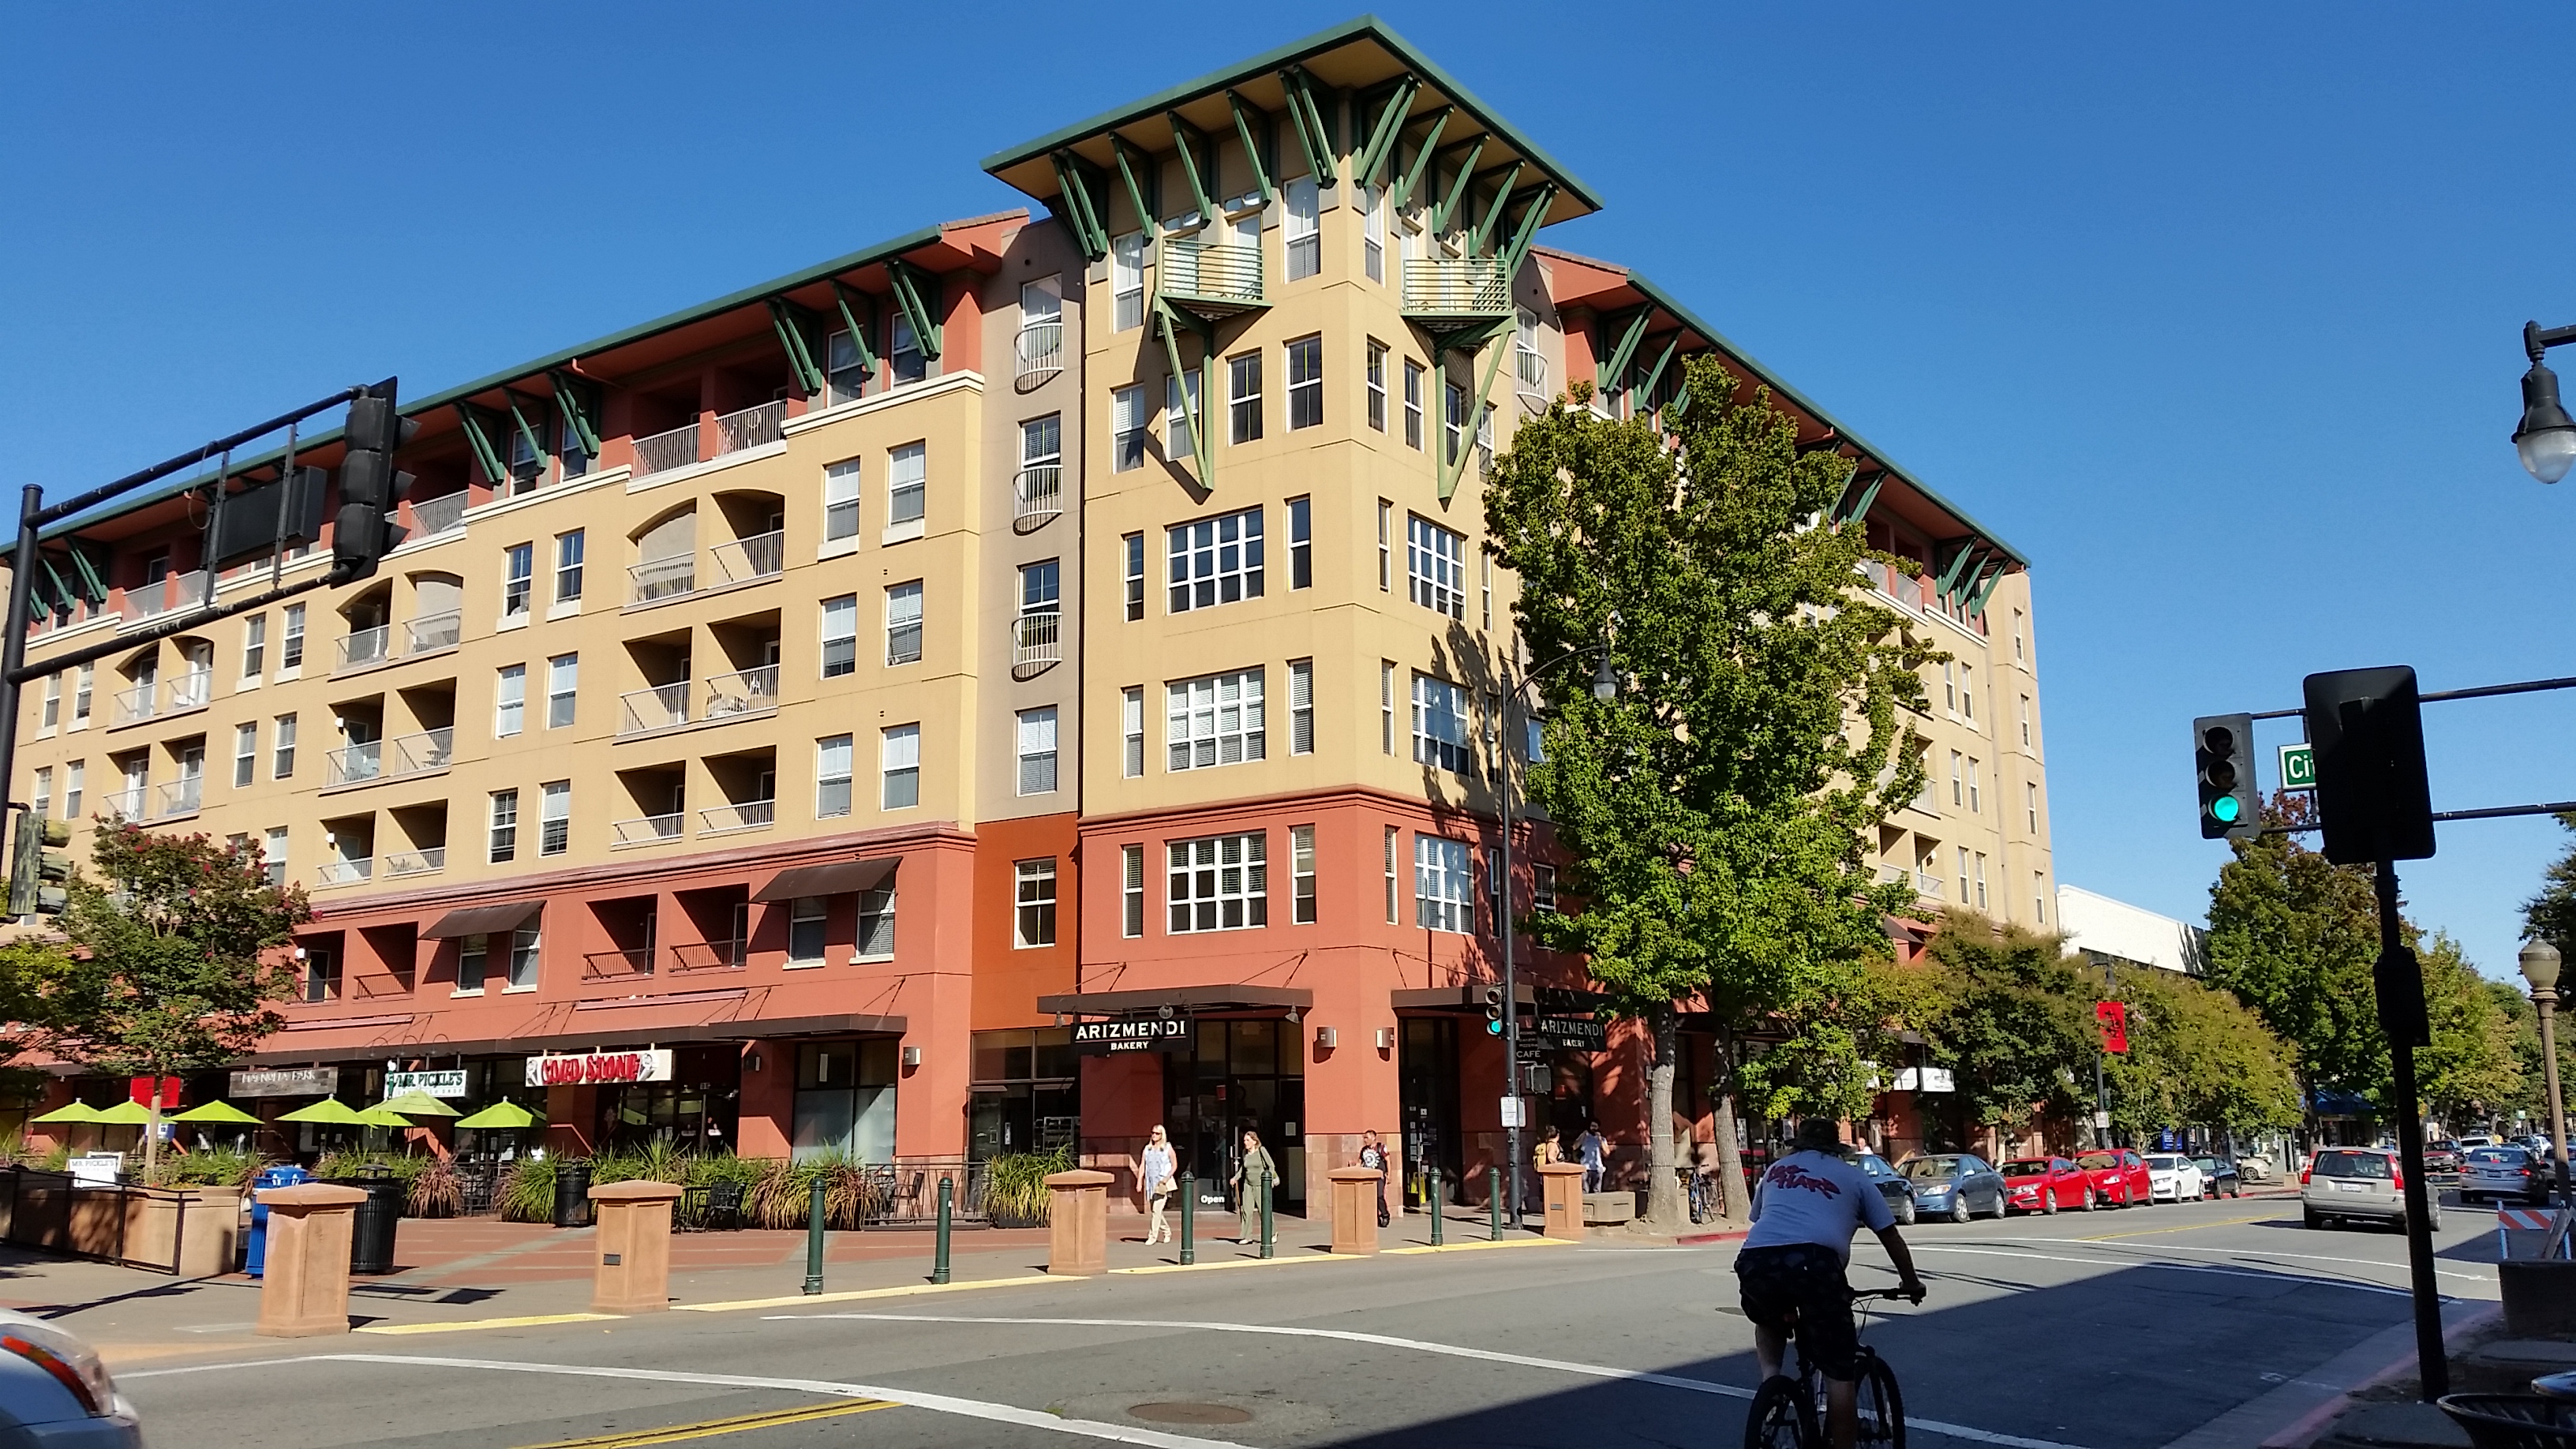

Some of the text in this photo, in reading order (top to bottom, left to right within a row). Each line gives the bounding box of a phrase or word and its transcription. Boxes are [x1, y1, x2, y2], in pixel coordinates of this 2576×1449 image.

[1076, 1020, 1186, 1039] ARIZMENDI
[1541, 1019, 1604, 1036] ARIZMENDI
[1110, 1041, 1149, 1050] BAKERY
[541, 1054, 641, 1084] COLD STONE
[418, 1072, 463, 1088] PICKLE'S
[1200, 1195, 1225, 1204] Open
